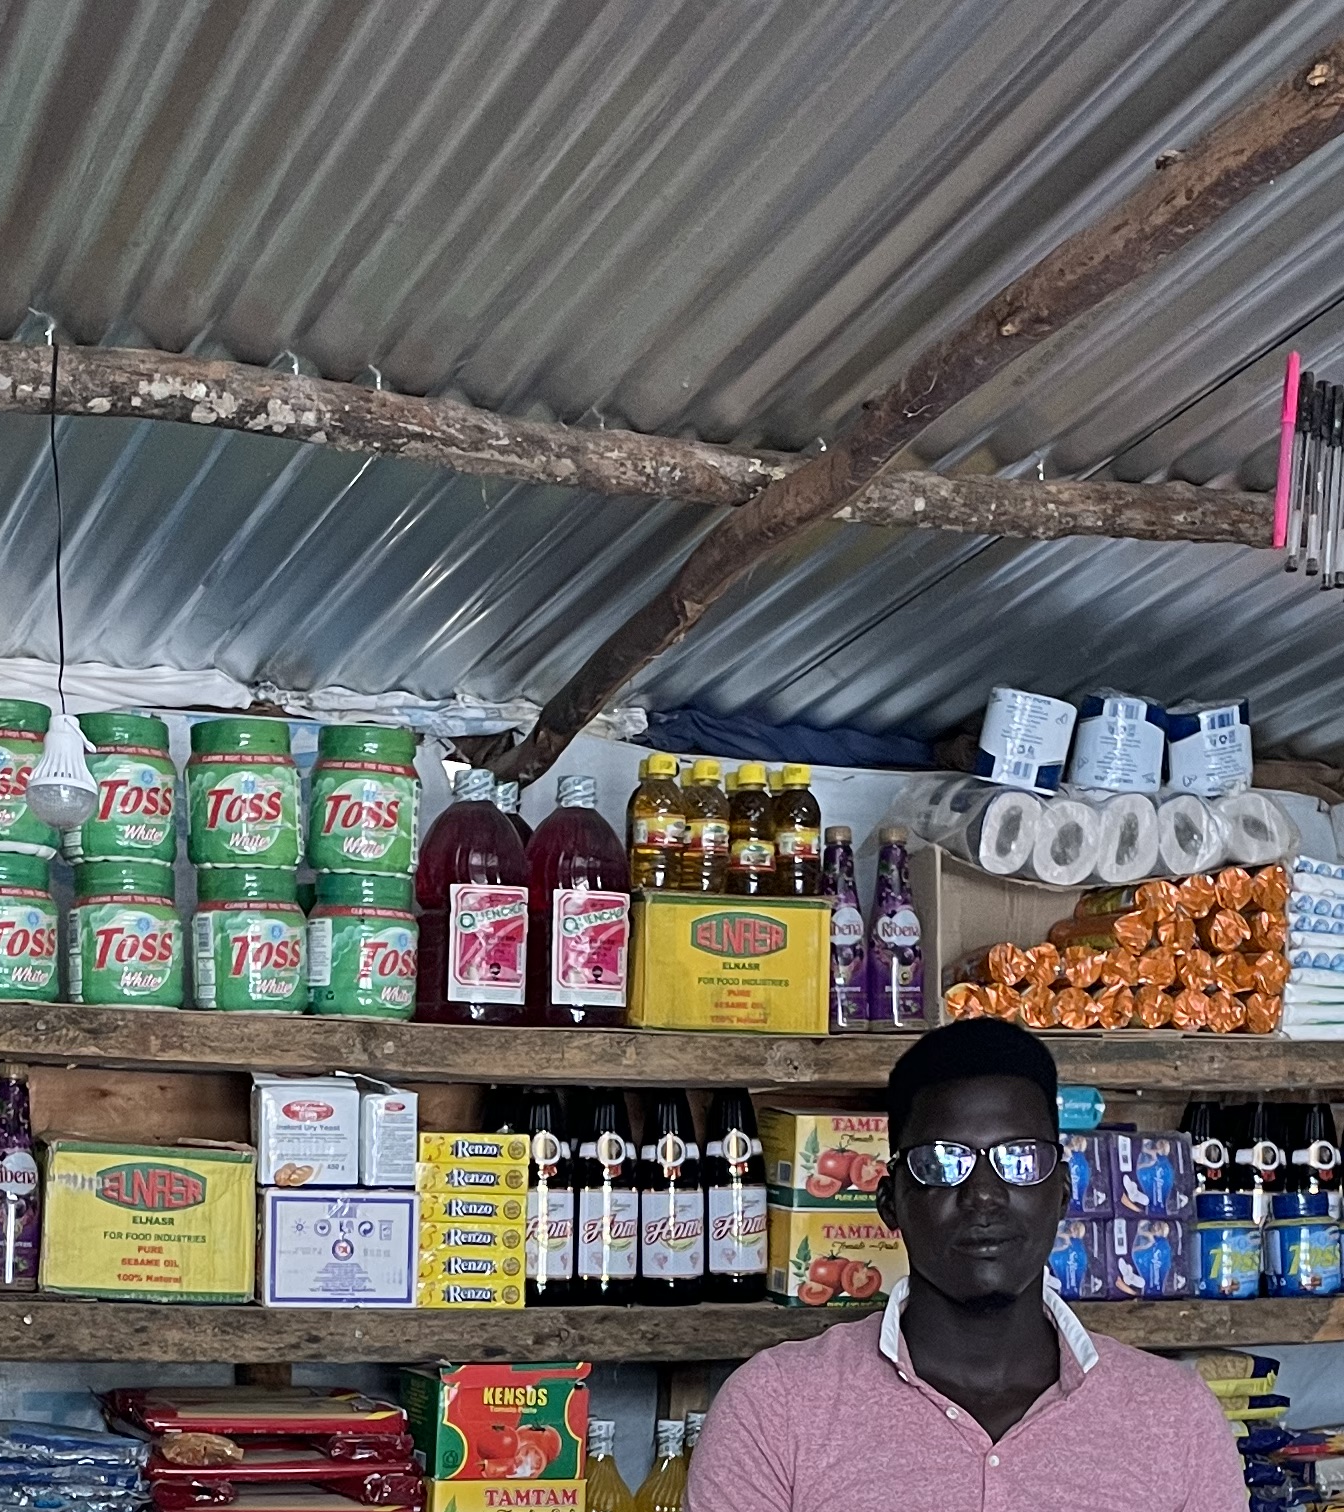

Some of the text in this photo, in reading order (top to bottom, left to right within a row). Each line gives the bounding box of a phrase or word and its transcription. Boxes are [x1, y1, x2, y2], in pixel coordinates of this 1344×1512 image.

[695, 916, 786, 954] ELNASR
[882, 920, 920, 938] Ribena
[722, 962, 761, 972] ELNASR
[697, 976, 715, 985] FOR
[717, 977, 739, 986] FOOD
[456, 1140, 499, 1158] Renzo
[452, 1169, 495, 1187] Renzo
[102, 1168, 203, 1208] ELNASR
[449, 1200, 493, 1218] Renzo
[132, 1215, 175, 1226] ELNASR
[103, 1231, 207, 1243] FOR FOOD INDUSTRIES
[449, 1229, 492, 1247] Renzo
[137, 1246, 164, 1255] PURE
[121, 1257, 160, 1268] SESAME
[449, 1257, 492, 1276] Renzo
[449, 1285, 491, 1303] Renzo
[483, 1387, 548, 1407] KENSOS
[484, 1488, 578, 1507] TAMTAM
